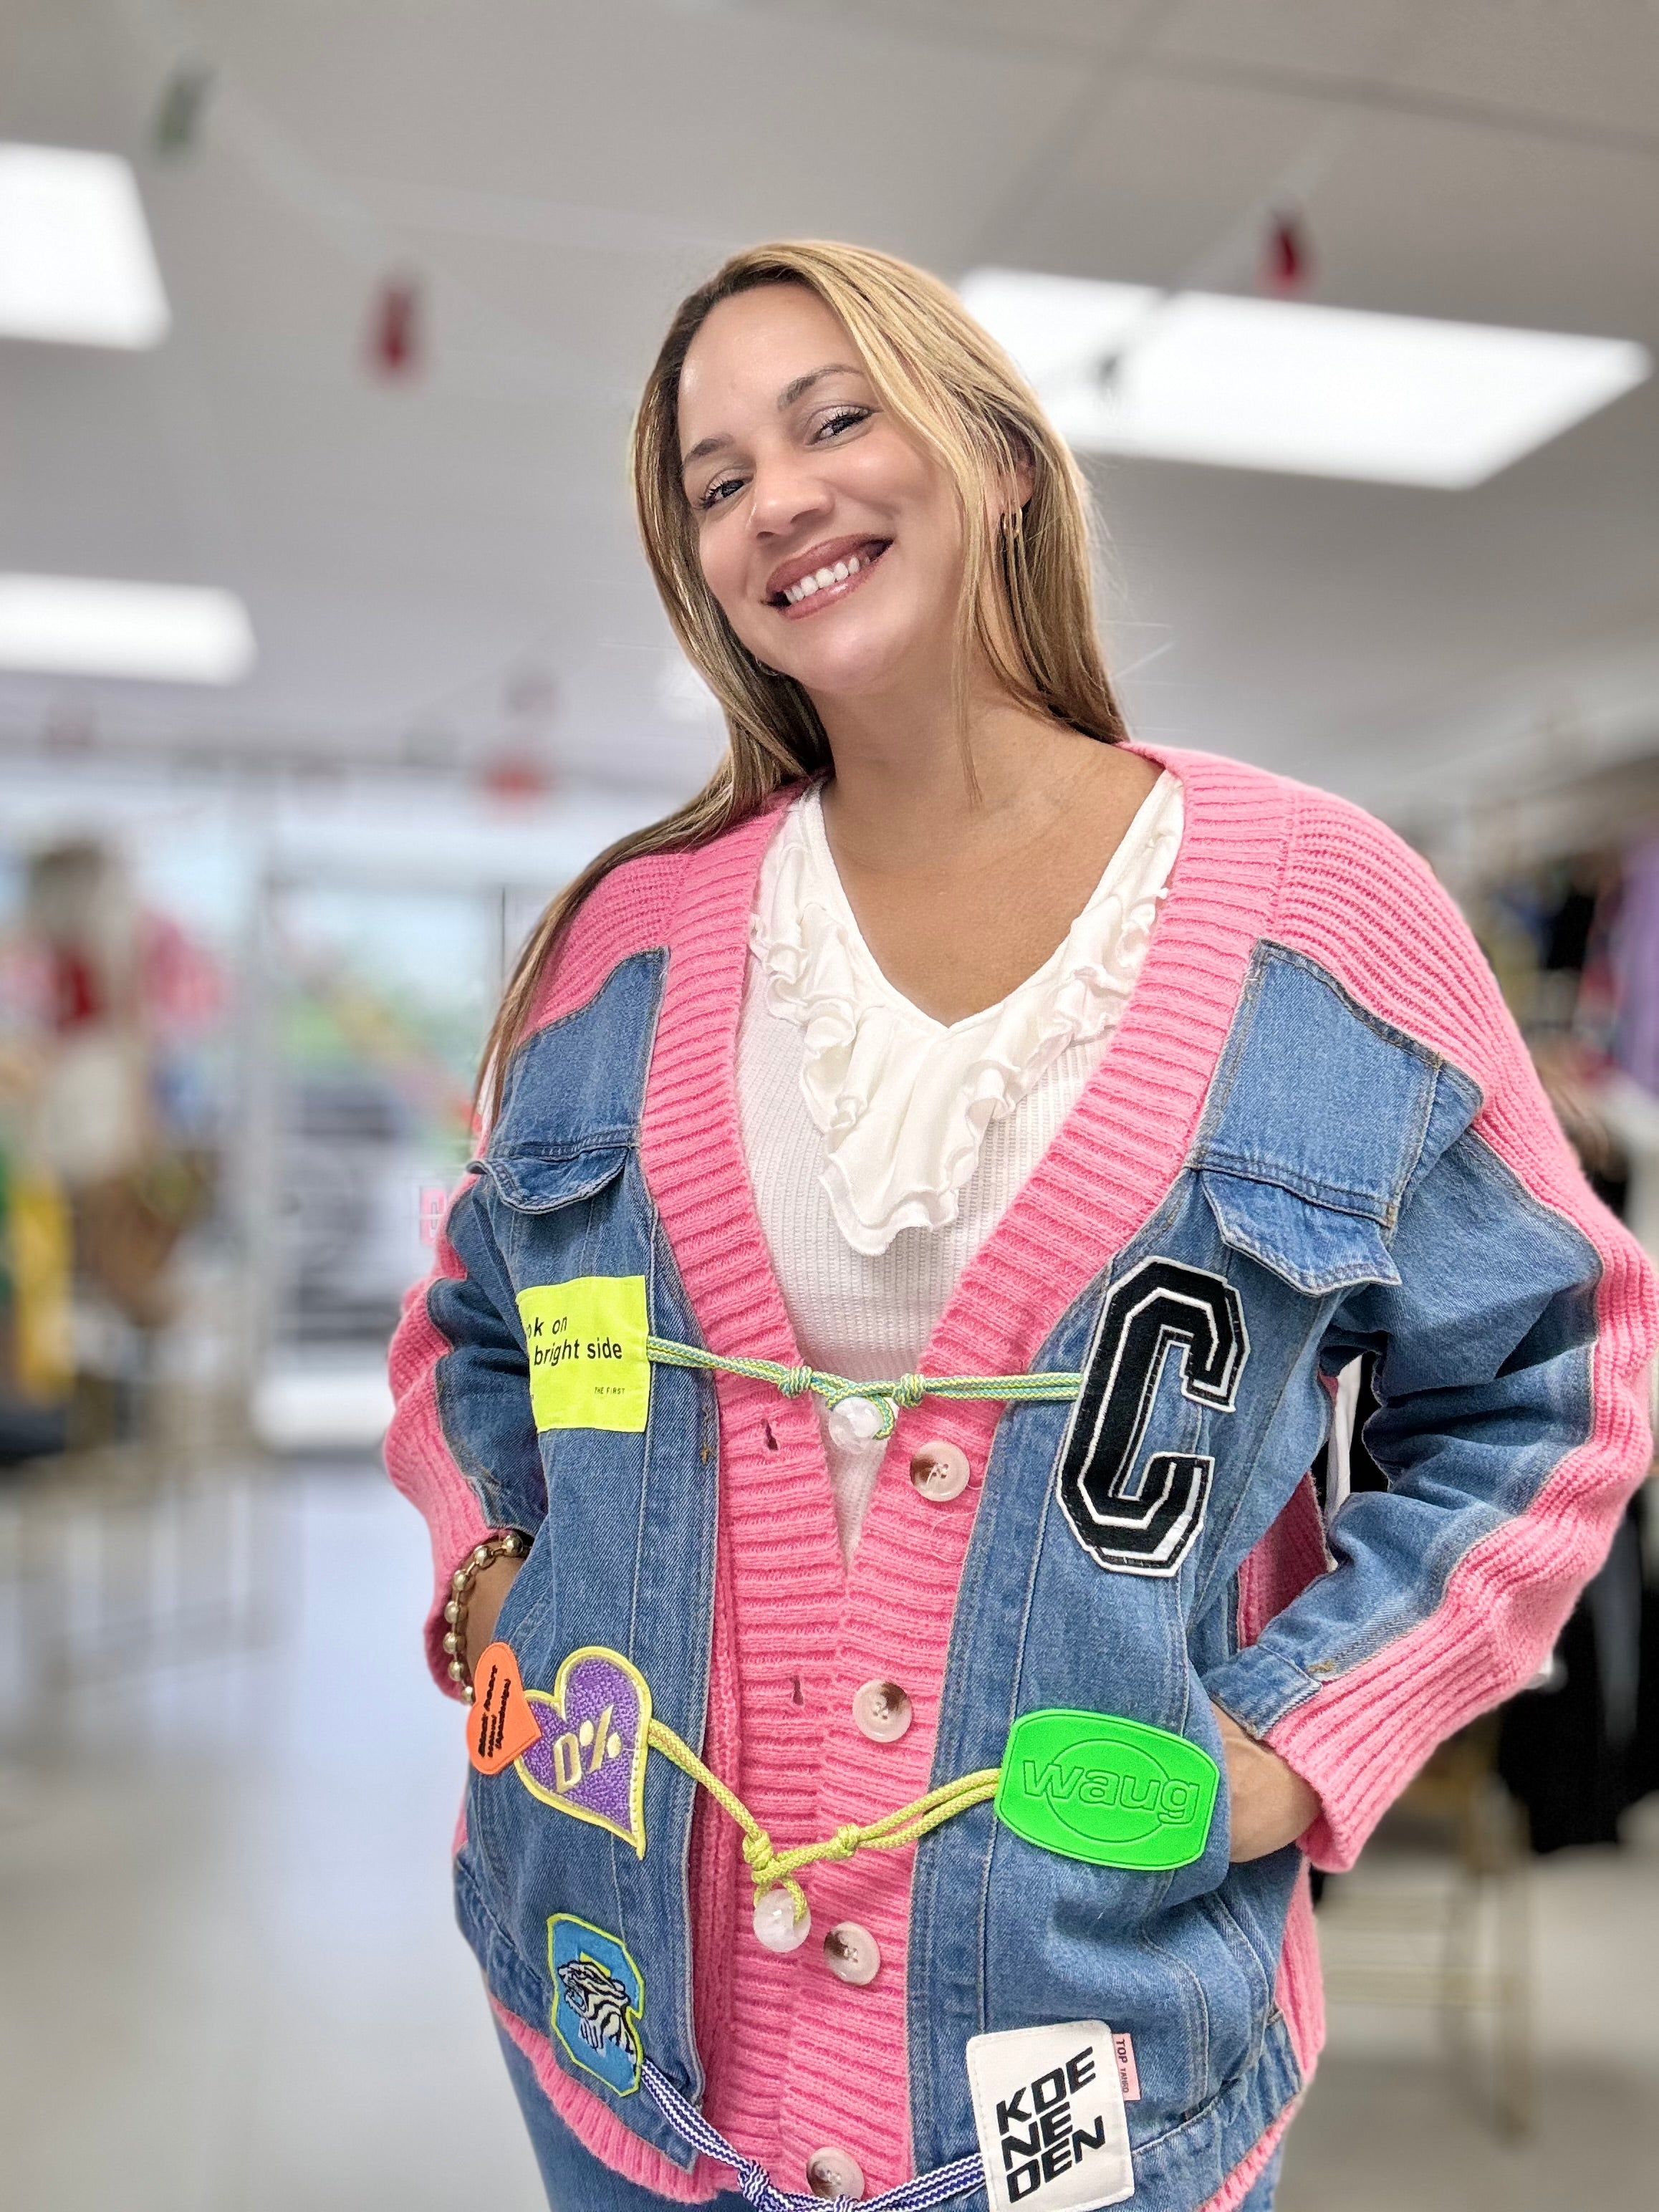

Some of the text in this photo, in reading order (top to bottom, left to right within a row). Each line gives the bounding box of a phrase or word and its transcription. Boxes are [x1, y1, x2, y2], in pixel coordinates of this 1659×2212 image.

[552, 1316, 568, 1335] on
[534, 1337, 623, 1367] bright side
[606, 1386, 625, 1395] FIRST
[1056, 1255, 1251, 1577] C
[1022, 1759, 1200, 1824] waug
[1116, 2039, 1128, 2064] TOP
[1001, 2101, 1073, 2172] NE
